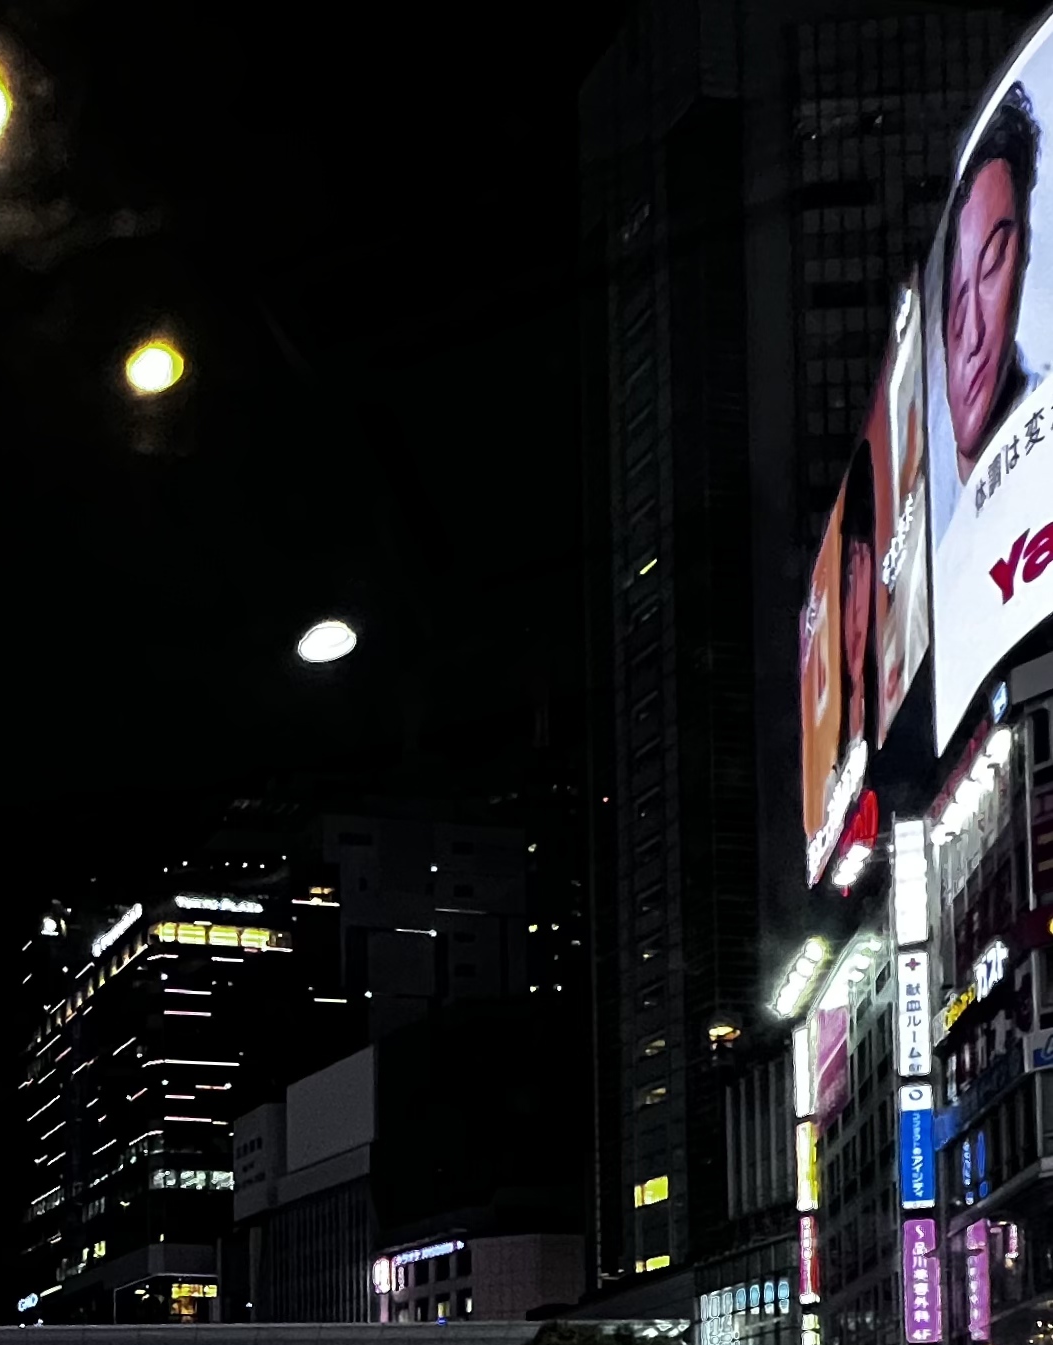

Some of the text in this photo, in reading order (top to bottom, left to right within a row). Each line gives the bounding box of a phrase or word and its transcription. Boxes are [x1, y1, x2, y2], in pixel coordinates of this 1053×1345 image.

[906, 983, 922, 1058] 献血ルーム
